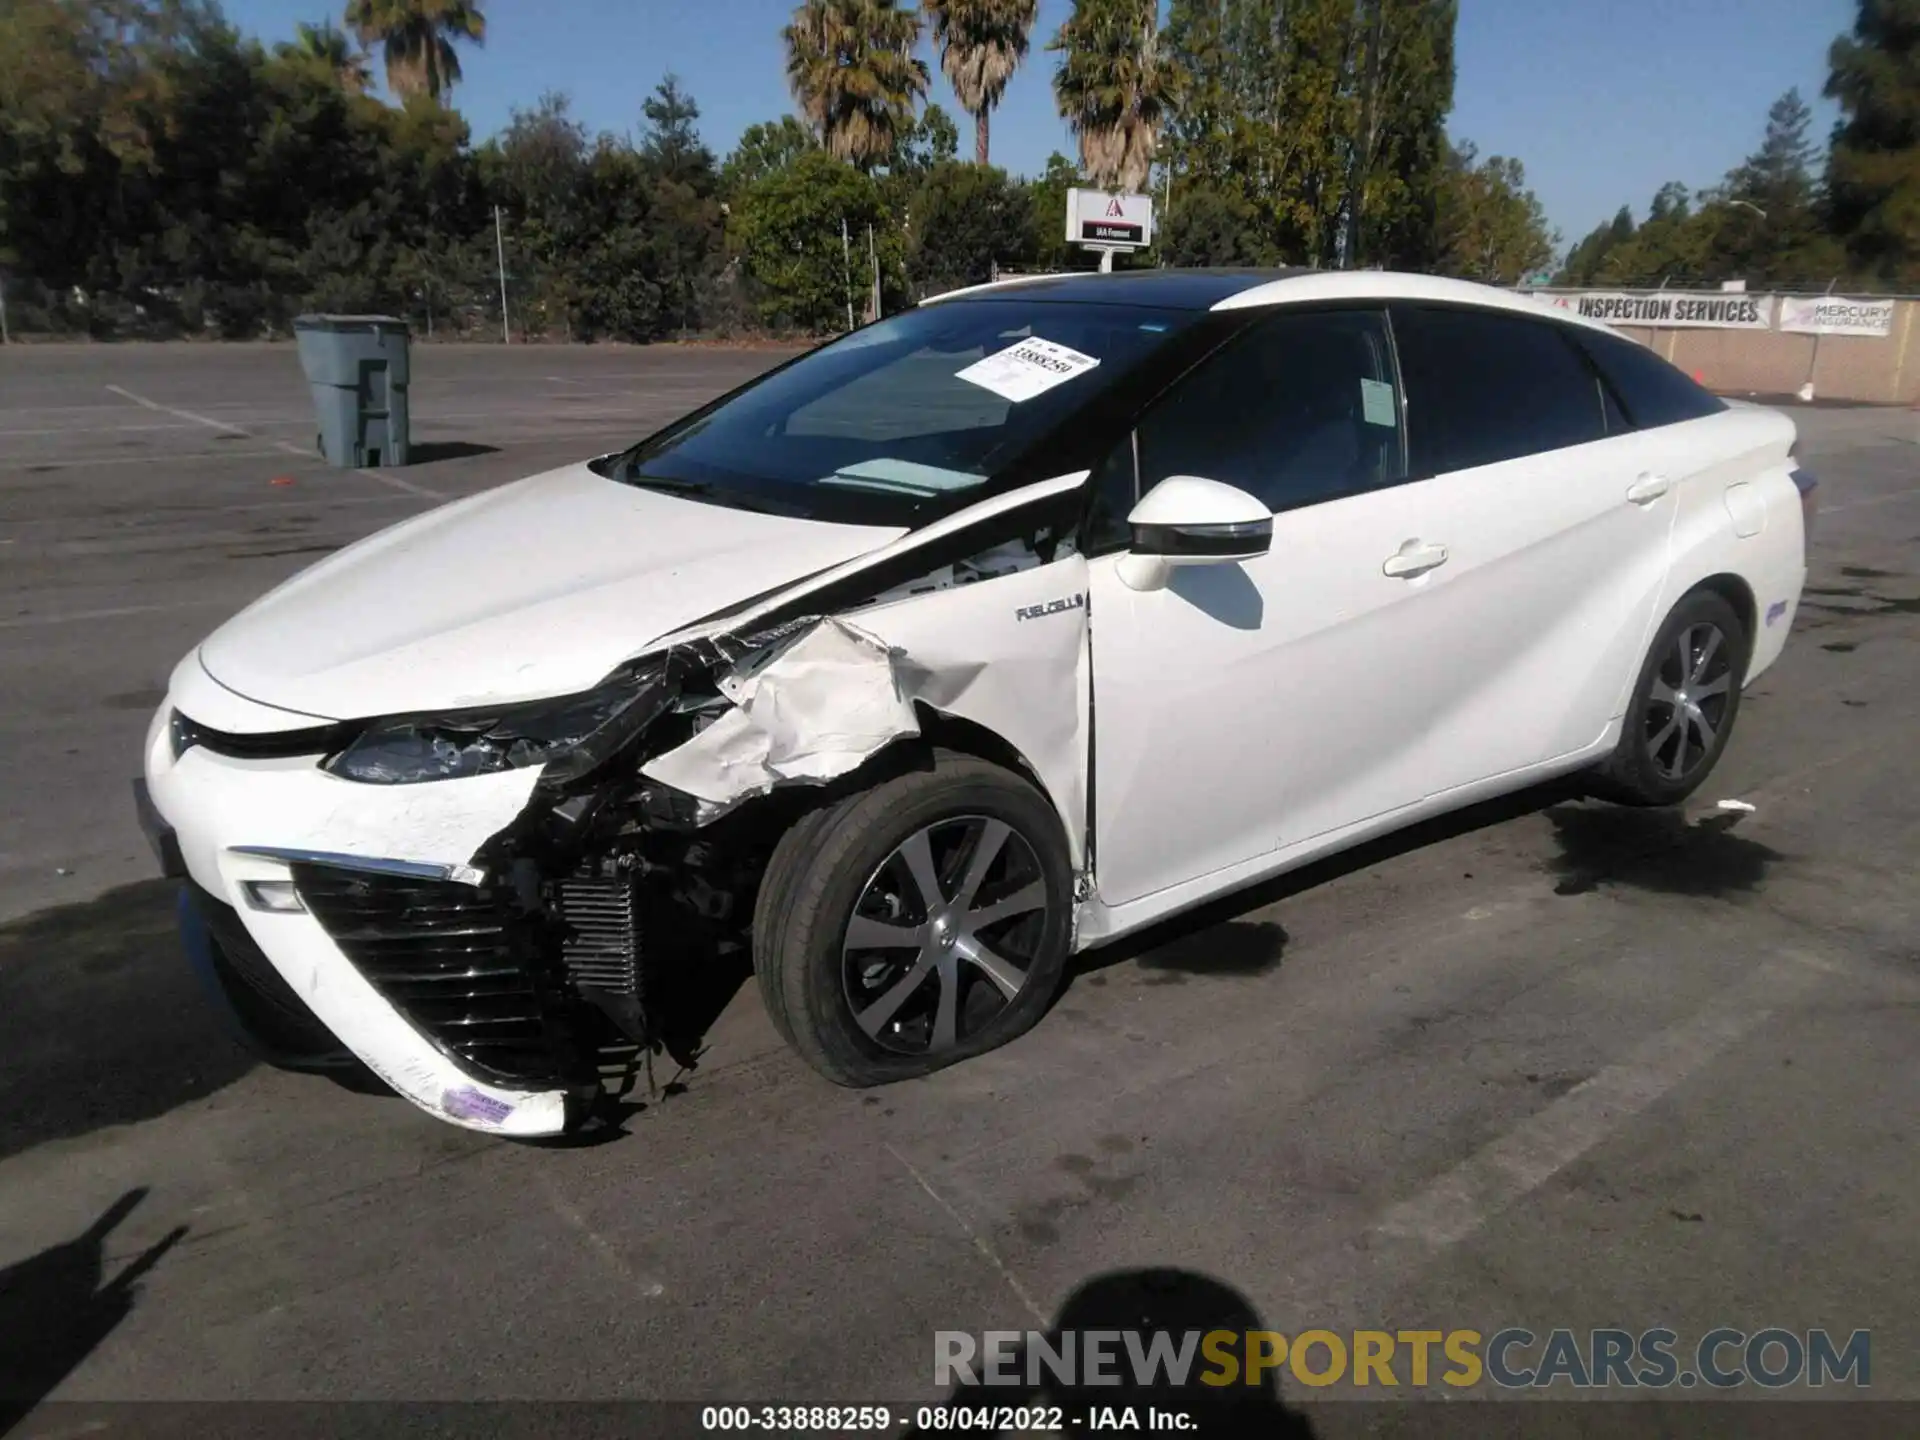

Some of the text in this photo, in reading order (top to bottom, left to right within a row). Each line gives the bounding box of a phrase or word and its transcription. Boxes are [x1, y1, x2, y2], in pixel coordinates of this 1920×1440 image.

[1578, 297, 1759, 322] INSPECTION SERVICES
[1815, 304, 1891, 318] MERCURY
[1813, 317, 1890, 328] INSURANCE
